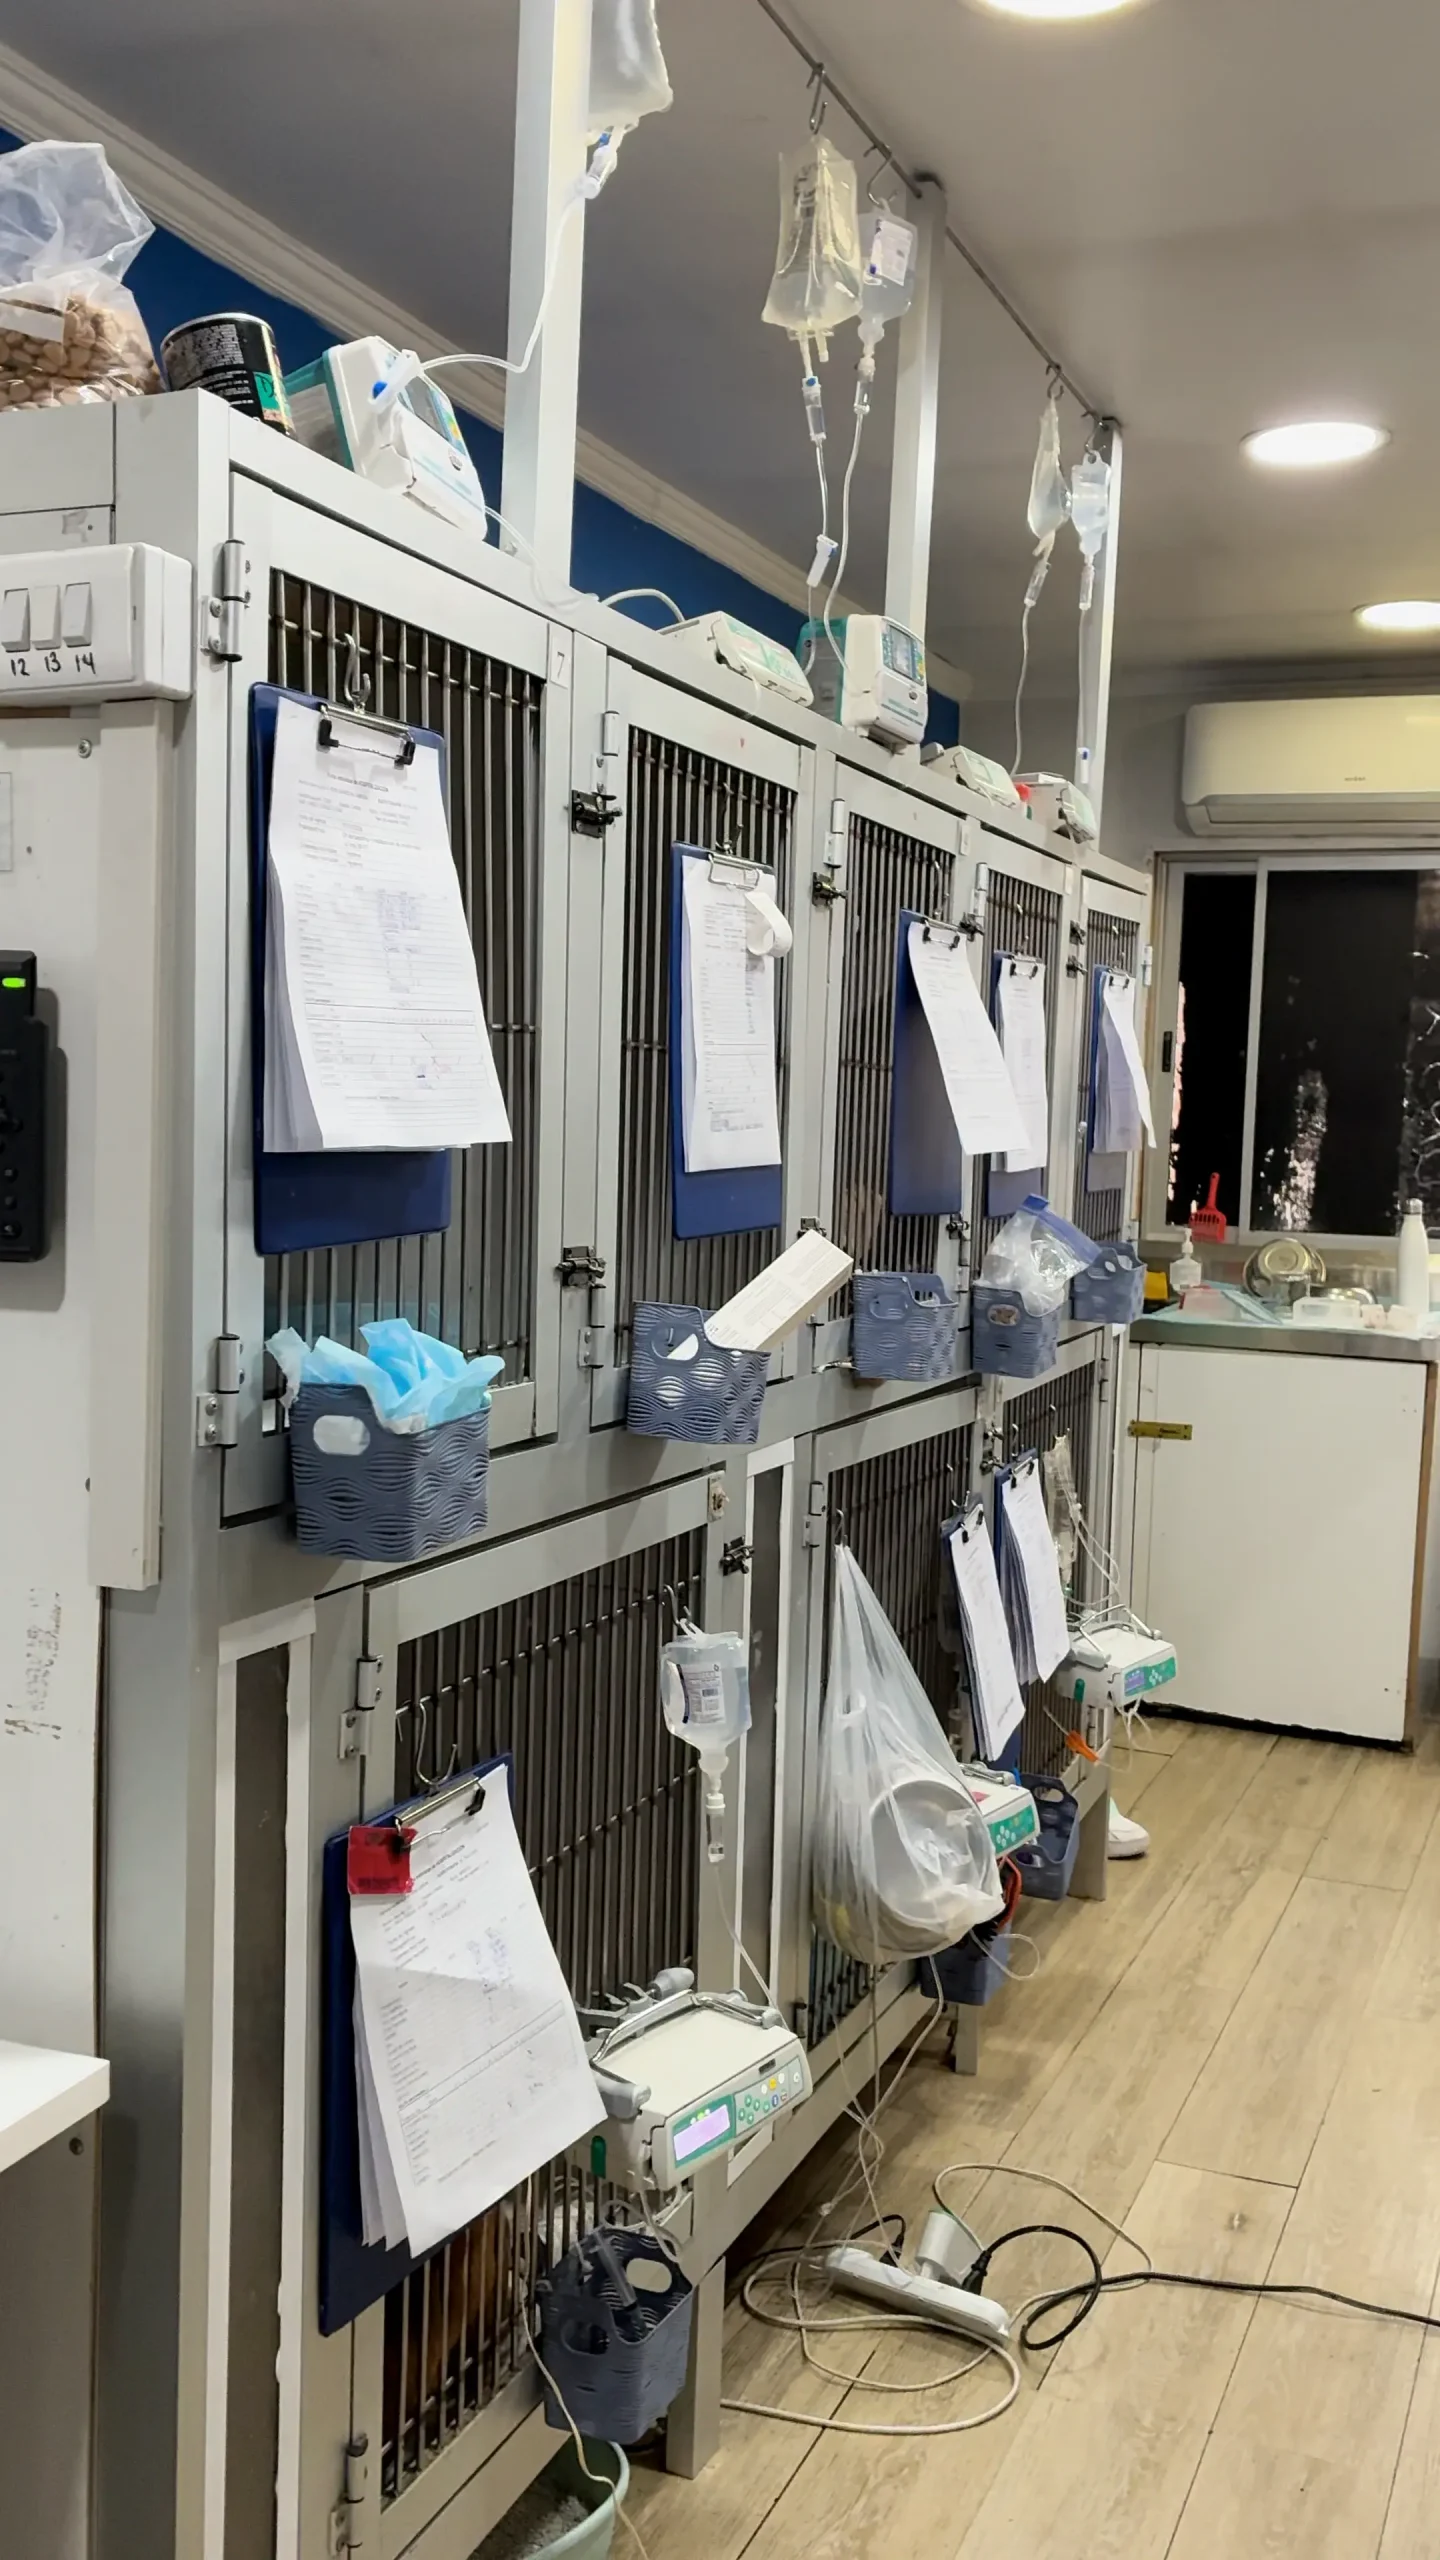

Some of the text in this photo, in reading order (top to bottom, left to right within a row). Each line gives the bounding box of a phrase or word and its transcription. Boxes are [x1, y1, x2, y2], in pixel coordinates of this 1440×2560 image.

[10, 651, 96, 676] 12 13 14
[557, 651, 565, 680] 7
